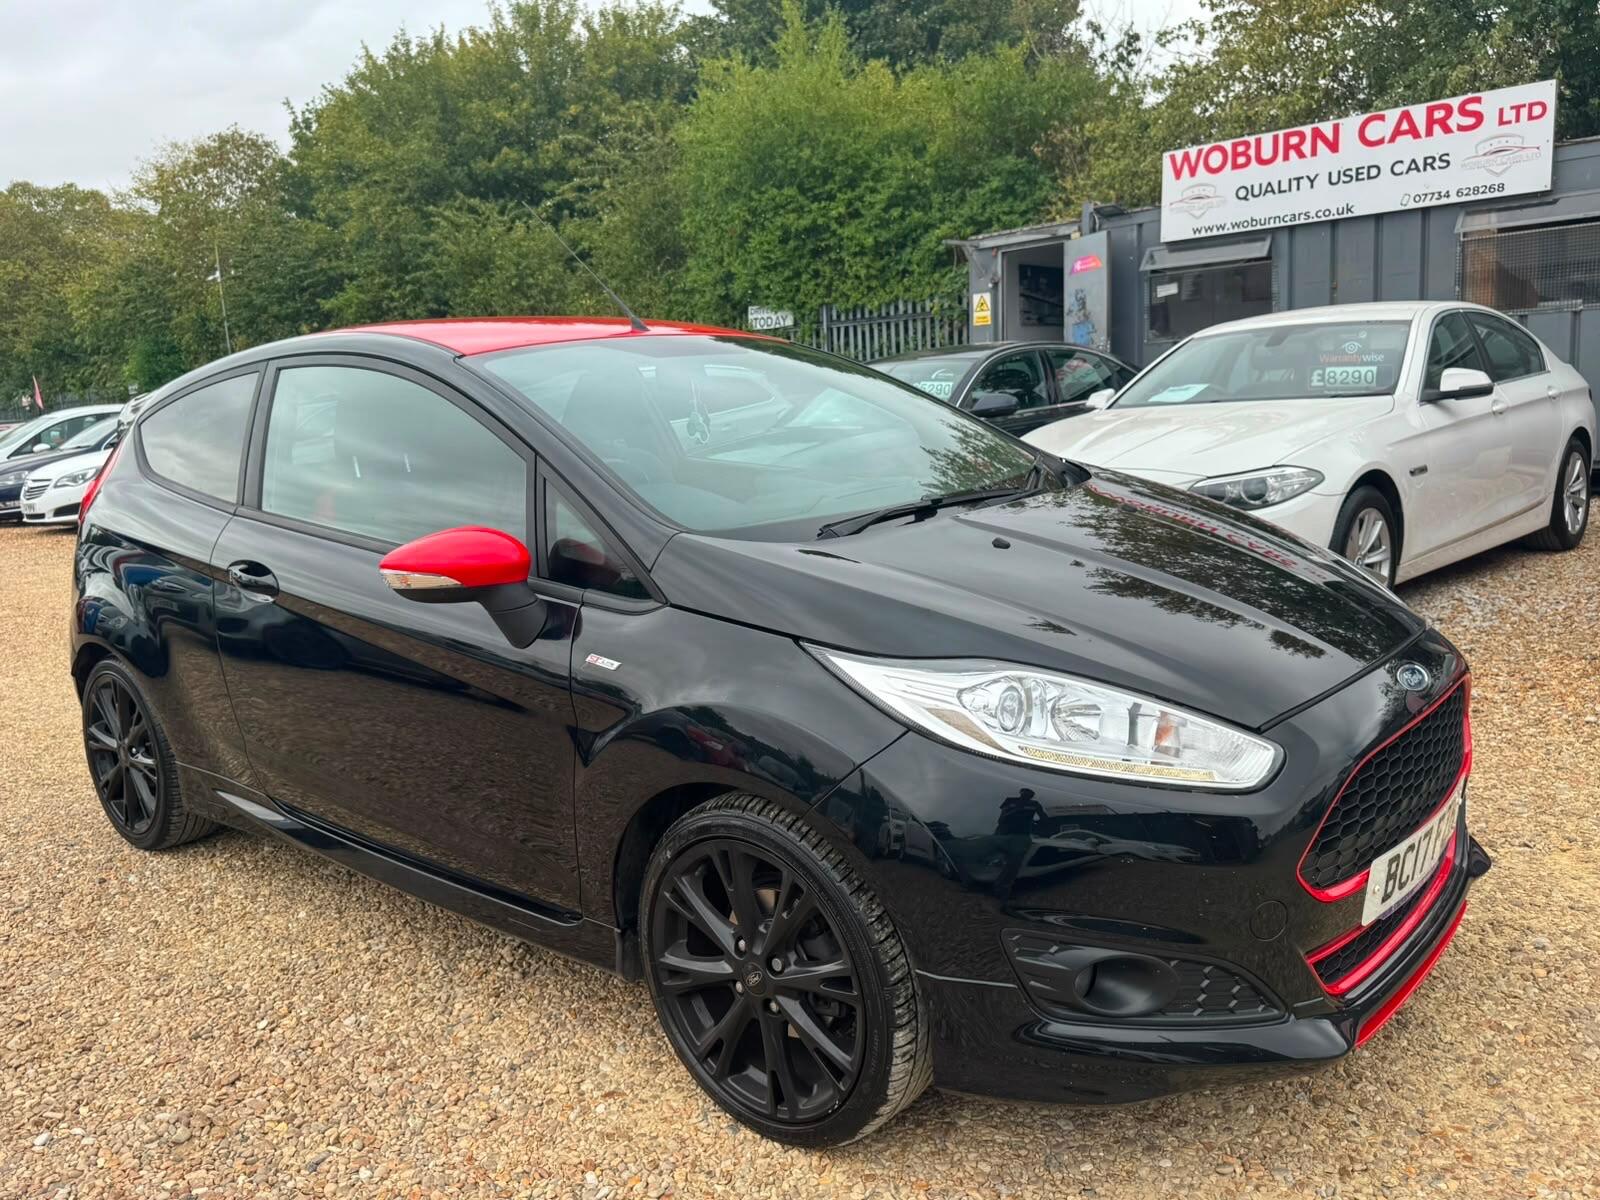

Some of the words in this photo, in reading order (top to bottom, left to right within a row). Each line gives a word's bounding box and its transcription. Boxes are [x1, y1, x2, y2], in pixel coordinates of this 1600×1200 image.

[1169, 122, 1340, 181] WOBURN
[1357, 96, 1485, 147] CARS
[1498, 101, 1548, 126] LTD
[1235, 173, 1320, 201] QUALITY
[1328, 164, 1381, 186] USED
[1390, 153, 1451, 176] CARS
[1413, 190, 1451, 204] 07734
[1456, 183, 1505, 198] 628268
[1192, 203, 1354, 235] www.woburncars.co.uk
[753, 314, 788, 328] TODAY
[1311, 369, 1374, 386] £8290
[1381, 825, 1434, 904] BC17
